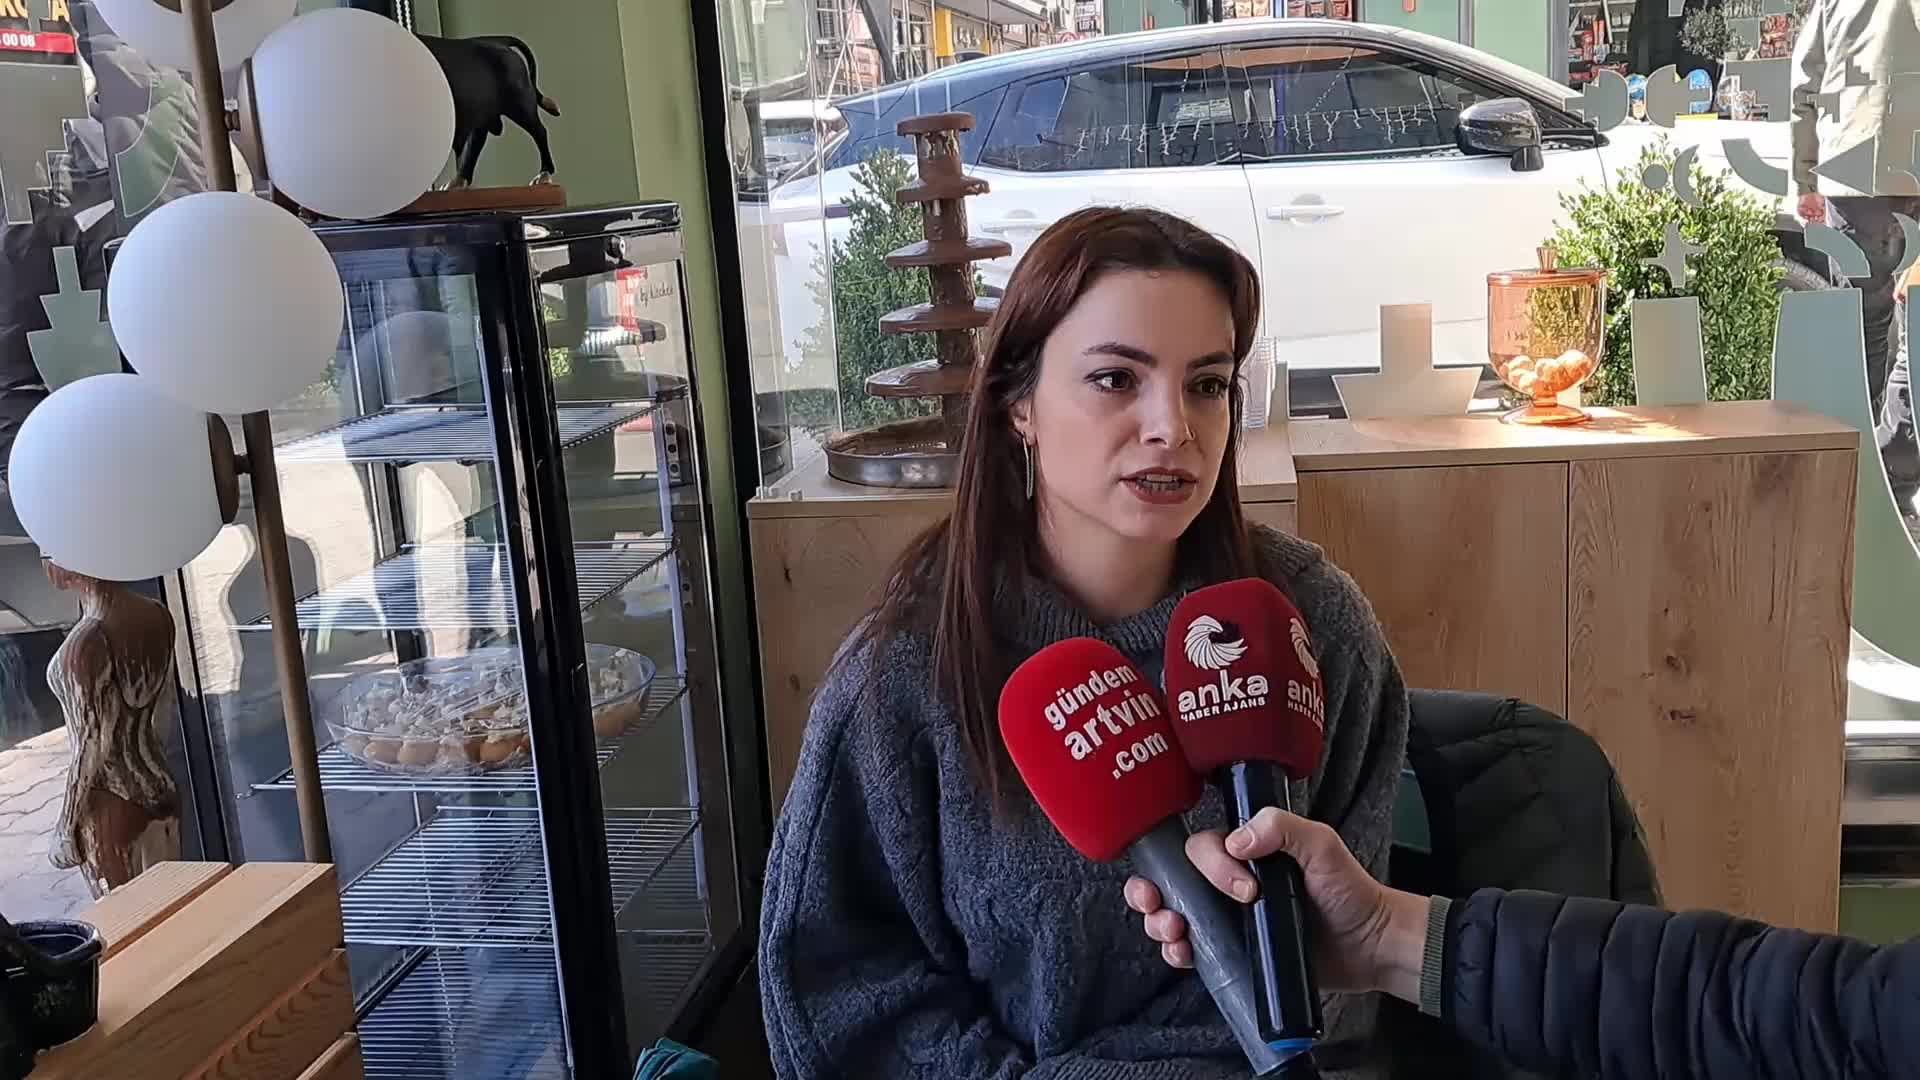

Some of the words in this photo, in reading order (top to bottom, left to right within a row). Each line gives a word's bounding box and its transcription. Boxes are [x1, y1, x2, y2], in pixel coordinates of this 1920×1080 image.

[1044, 665, 1138, 731] gündem
[1177, 669, 1269, 713] anka
[1180, 704, 1220, 722] HABER
[1223, 696, 1266, 713] AJANS
[1064, 689, 1161, 760] artvin
[1112, 733, 1169, 779] .com
